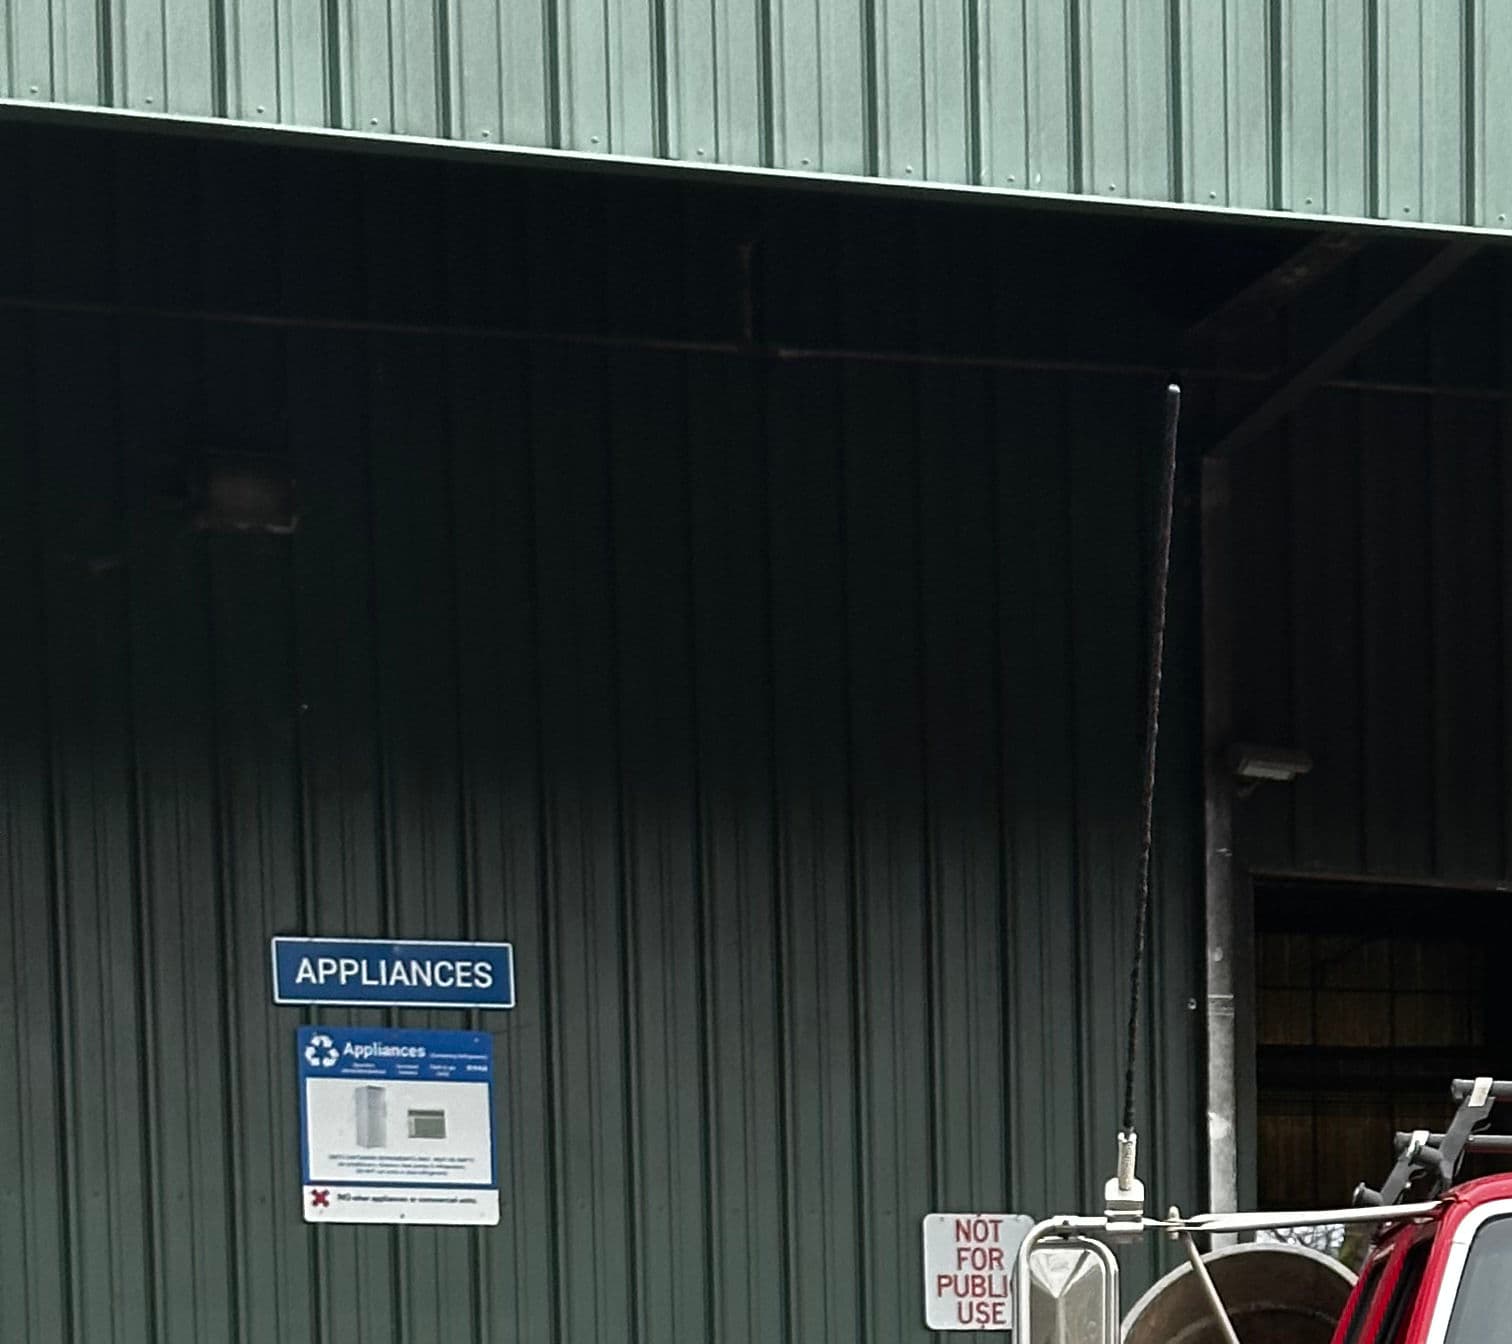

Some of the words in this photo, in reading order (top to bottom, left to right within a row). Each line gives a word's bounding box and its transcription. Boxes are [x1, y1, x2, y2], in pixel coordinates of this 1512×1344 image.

[296, 957, 493, 989] APPLIANCES
[342, 1041, 427, 1059] Appliances
[954, 1219, 1004, 1243] NOT
[957, 1247, 1005, 1271] FOR
[936, 1273, 1010, 1299] PUBLI
[957, 1301, 1006, 1325] USE
